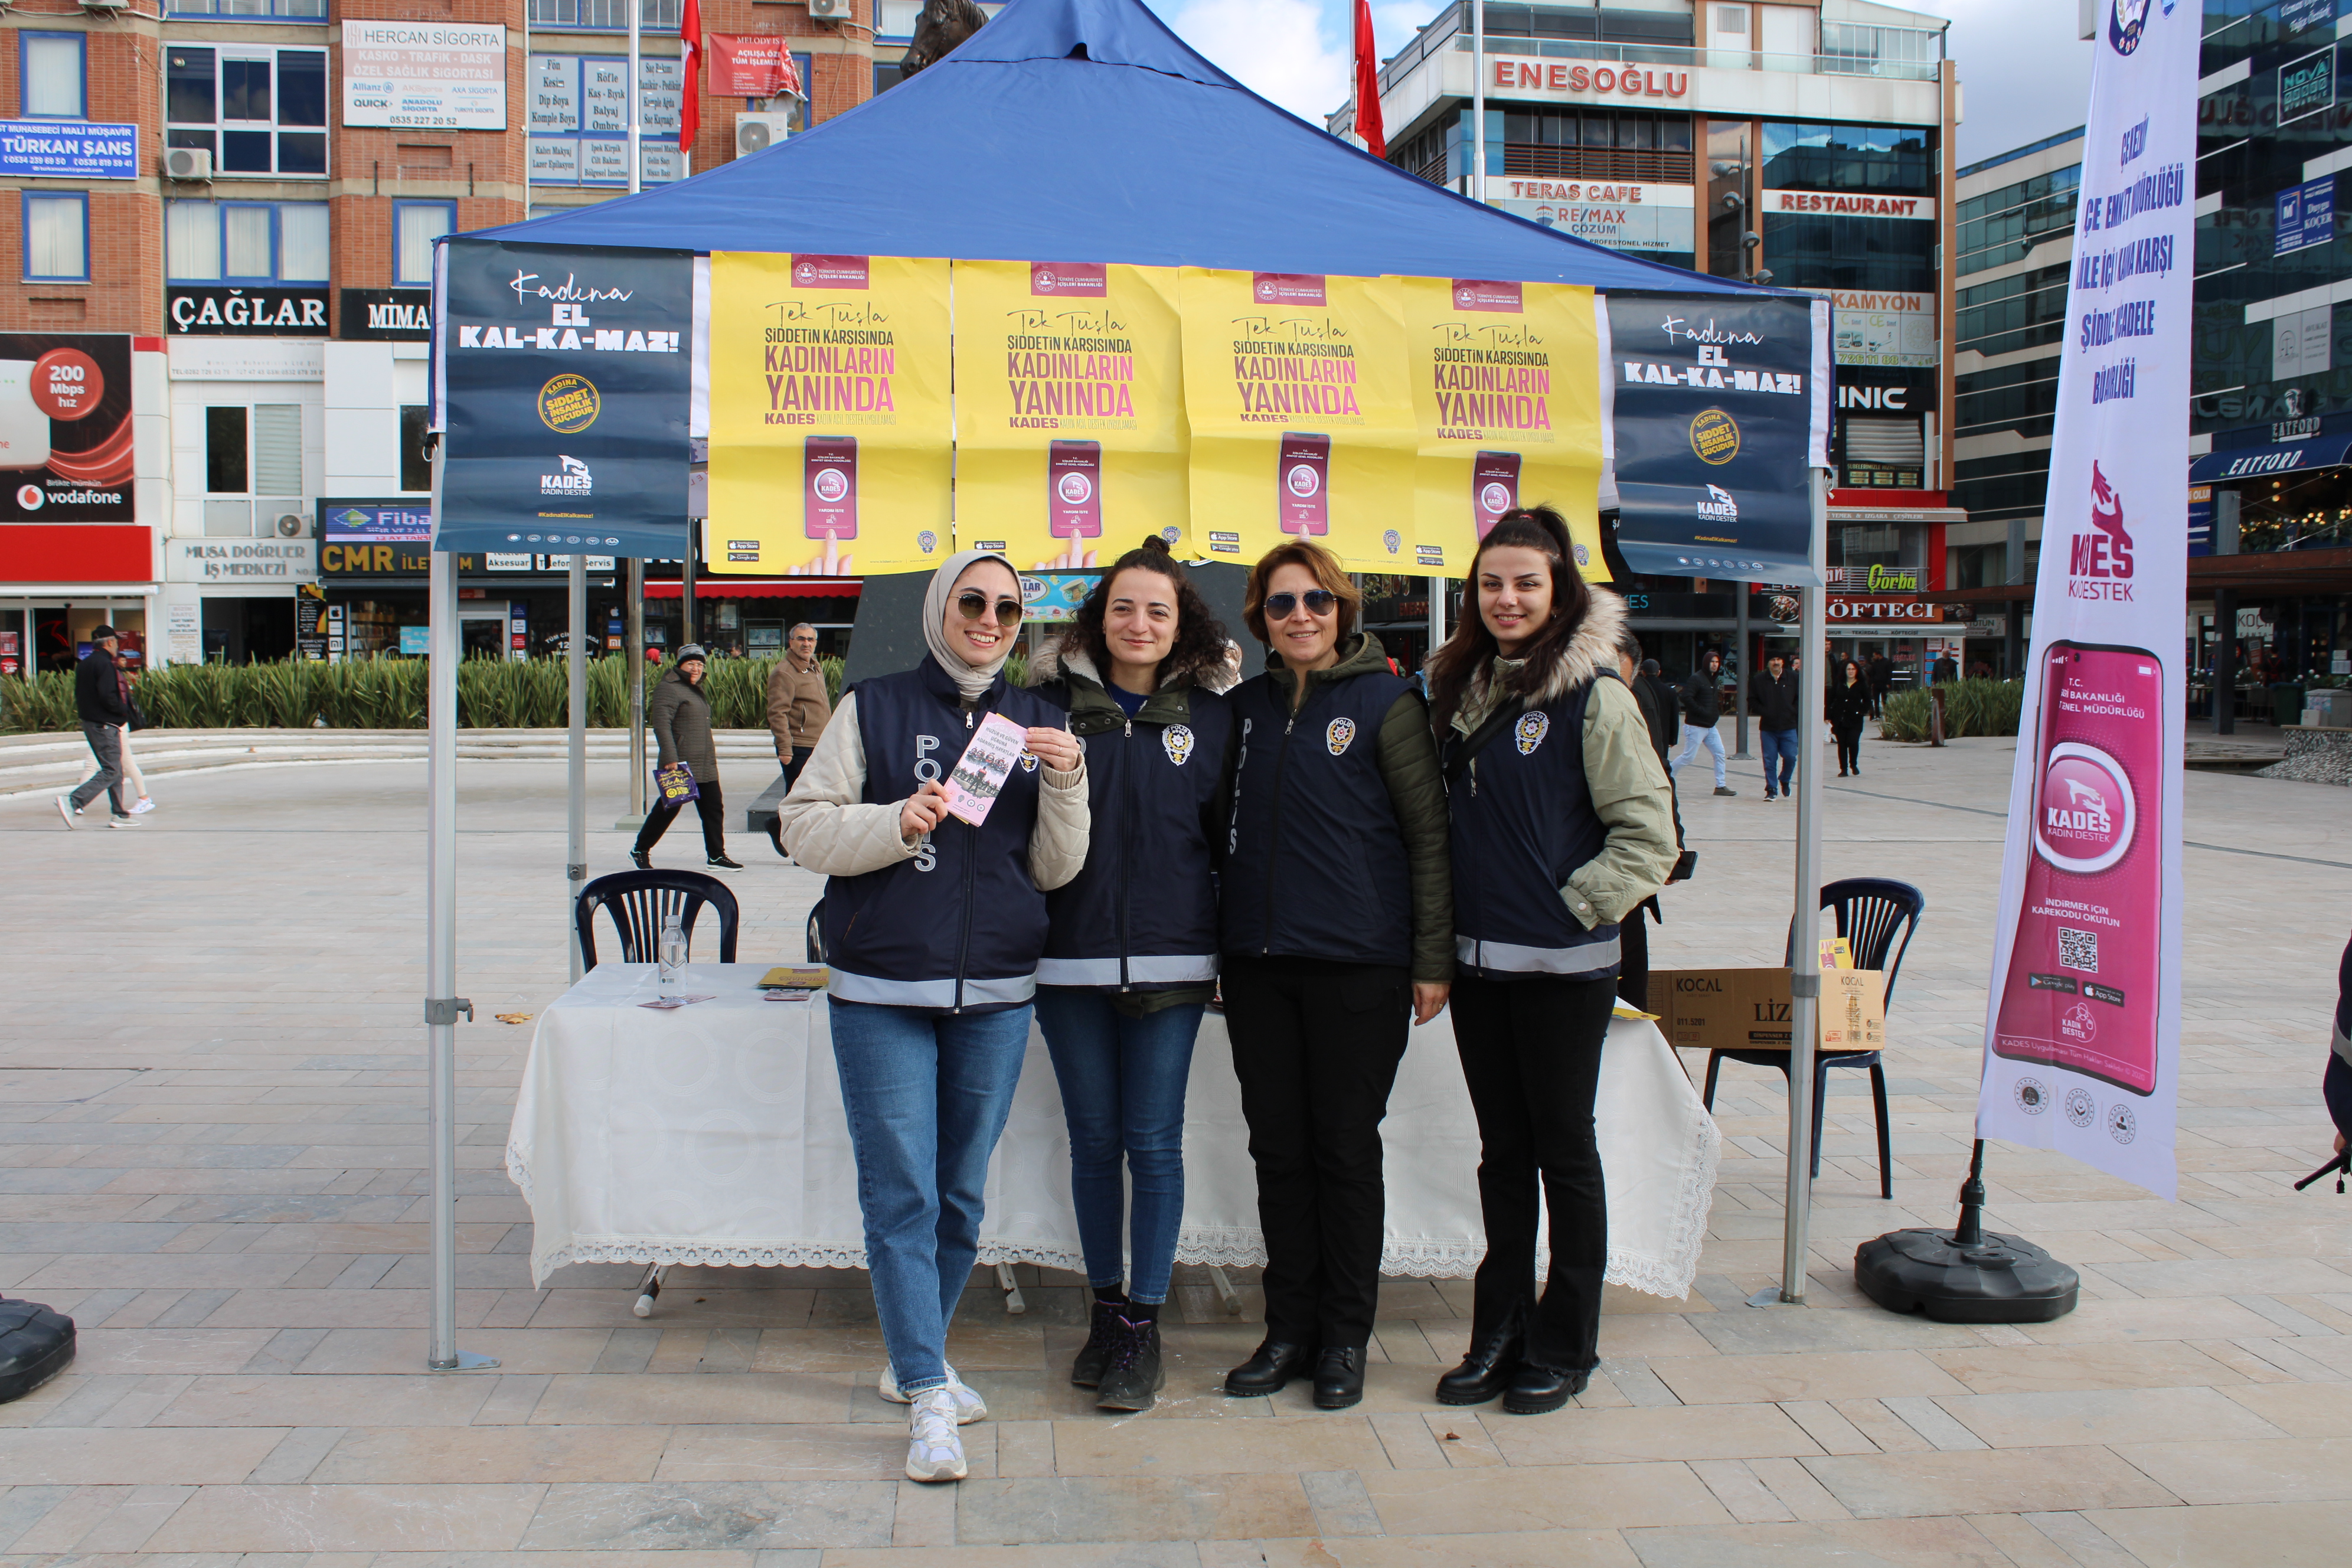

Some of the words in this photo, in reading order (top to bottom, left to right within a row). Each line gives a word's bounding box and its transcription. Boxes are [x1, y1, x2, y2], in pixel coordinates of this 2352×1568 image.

[365, 30, 428, 44] HERCAN
[433, 30, 499, 46] SİGORTA
[359, 51, 399, 61] KASKO
[410, 51, 450, 63] TRAFİK
[460, 53, 491, 64] DASK
[547, 59, 560, 70] Fön
[354, 64, 383, 76] ÖZEL
[387, 64, 429, 77] SAĞLIK
[433, 68, 493, 79] SİGORTASI
[597, 73, 618, 83] Röfle
[1495, 61, 1687, 97] ENESOĞLU
[352, 83, 381, 91] Allianz
[544, 77, 564, 87] Kesim
[539, 94, 550, 107] Dip
[553, 95, 569, 106] Boya
[588, 88, 601, 100] Kaş
[607, 89, 625, 100] Bıyık
[532, 112, 557, 125] Komple
[560, 113, 576, 124] Boya
[594, 106, 618, 117] Balyaj
[9, 125, 60, 135] MUHASEBECİ
[63, 126, 86, 135] MALİ
[89, 127, 132, 138] MÜŞAVİR
[593, 120, 619, 130] Ombre
[2, 136, 79, 154] TÜRKAN
[83, 141, 132, 157] ŞANS
[552, 146, 571, 157] Makyaj
[604, 144, 621, 153] Kirpik
[533, 159, 547, 168] Lazer
[548, 160, 574, 170] Epilasyon
[584, 168, 606, 178] Bölgesel
[607, 167, 628, 177] İncelme
[1511, 181, 1581, 200] TERAS
[1588, 184, 1641, 202] CAFE
[1781, 194, 1917, 215] RESTAURANT
[1559, 208, 1626, 223] RE/MAX
[1572, 223, 1616, 235] ÇÖZÜM
[509, 269, 633, 305] Kadına
[1832, 293, 1920, 311] KAMYON
[172, 289, 326, 332] ÇAĞLAR
[553, 304, 590, 326] EL
[765, 301, 814, 326] Tek
[1870, 315, 1884, 327] CE
[765, 328, 819, 344] ŞİDDETİN
[824, 329, 894, 346] KARŞISINDA
[1661, 315, 1765, 346] Kadına
[459, 326, 680, 352] KAL-KA-MAZ!
[1008, 335, 1060, 351] ŞİDDETİN
[1064, 338, 1131, 354] KARŞISINDA
[1234, 341, 1286, 355] ŞİDDETİN
[1289, 342, 1354, 358] KARŞISINDA
[1698, 345, 1728, 367] EL
[765, 346, 894, 374] KADINLARIN
[1435, 348, 1484, 363] ŞİDDETİN
[1486, 349, 1549, 367] KARŞISINDA
[1839, 354, 1864, 364] 726
[1867, 355, 1878, 364] 11
[1882, 355, 1898, 364] 88
[50, 366, 84, 381] 200
[1008, 352, 1133, 381] KADINLARIN
[1234, 357, 1357, 384] KADINLARIN
[1435, 365, 1549, 394] KADINLARIN
[1624, 362, 1801, 395] KAL-KA-MAZ!
[50, 383, 84, 396] Mbps
[547, 379, 577, 395] KADINA
[765, 375, 894, 411] YANINDA
[59, 397, 77, 407] hız
[1010, 381, 1134, 417] YANINDA
[1237, 382, 1361, 416] YANINDA
[765, 413, 815, 424] KADES
[1240, 414, 1289, 423] KADES
[1436, 392, 1551, 430] YANINDA
[1010, 417, 1059, 429] KADES
[1696, 414, 1721, 428] KADINA
[2272, 417, 2320, 437] EATFORD
[1438, 428, 1483, 440] KADES
[2228, 450, 2302, 475] EATFORD
[542, 475, 592, 488] KADES
[47, 490, 122, 504] vodafone
[187, 546, 228, 558] MUSA
[233, 543, 305, 558] DOĞRUER
[322, 545, 394, 571] CMR
[205, 564, 219, 579] İŞ
[223, 563, 286, 575] MERKEZİ
[1868, 564, 1916, 593] Çorba
[2069, 678, 2083, 687] T.C.
[2070, 691, 2125, 703] BAKANLIĞI
[2083, 704, 2145, 718] MÜDÜRLÜĞÜ
[986, 727, 999, 736] HUZUR
[1005, 736, 1019, 745] GÜVEN
[991, 736, 1007, 747] UĞRUNA
[977, 737, 995, 749] ADANMIŞ
[995, 746, 1015, 757] HAYATLAR
[1230, 718, 1251, 855] POLİS
[2048, 807, 2111, 833] KADES
[2047, 827, 2073, 839] KADIN
[2032, 906, 2081, 920] KAREKODU
[2083, 913, 2120, 927] OKUTUN
[2091, 904, 2108, 915] İÇİN
[2043, 979, 2063, 988] Google
[2095, 991, 2106, 999] App
[2108, 994, 2121, 1003] Store
[2062, 1019, 2081, 1030] KADIN
[2062, 1027, 2085, 1039] DESTEK
